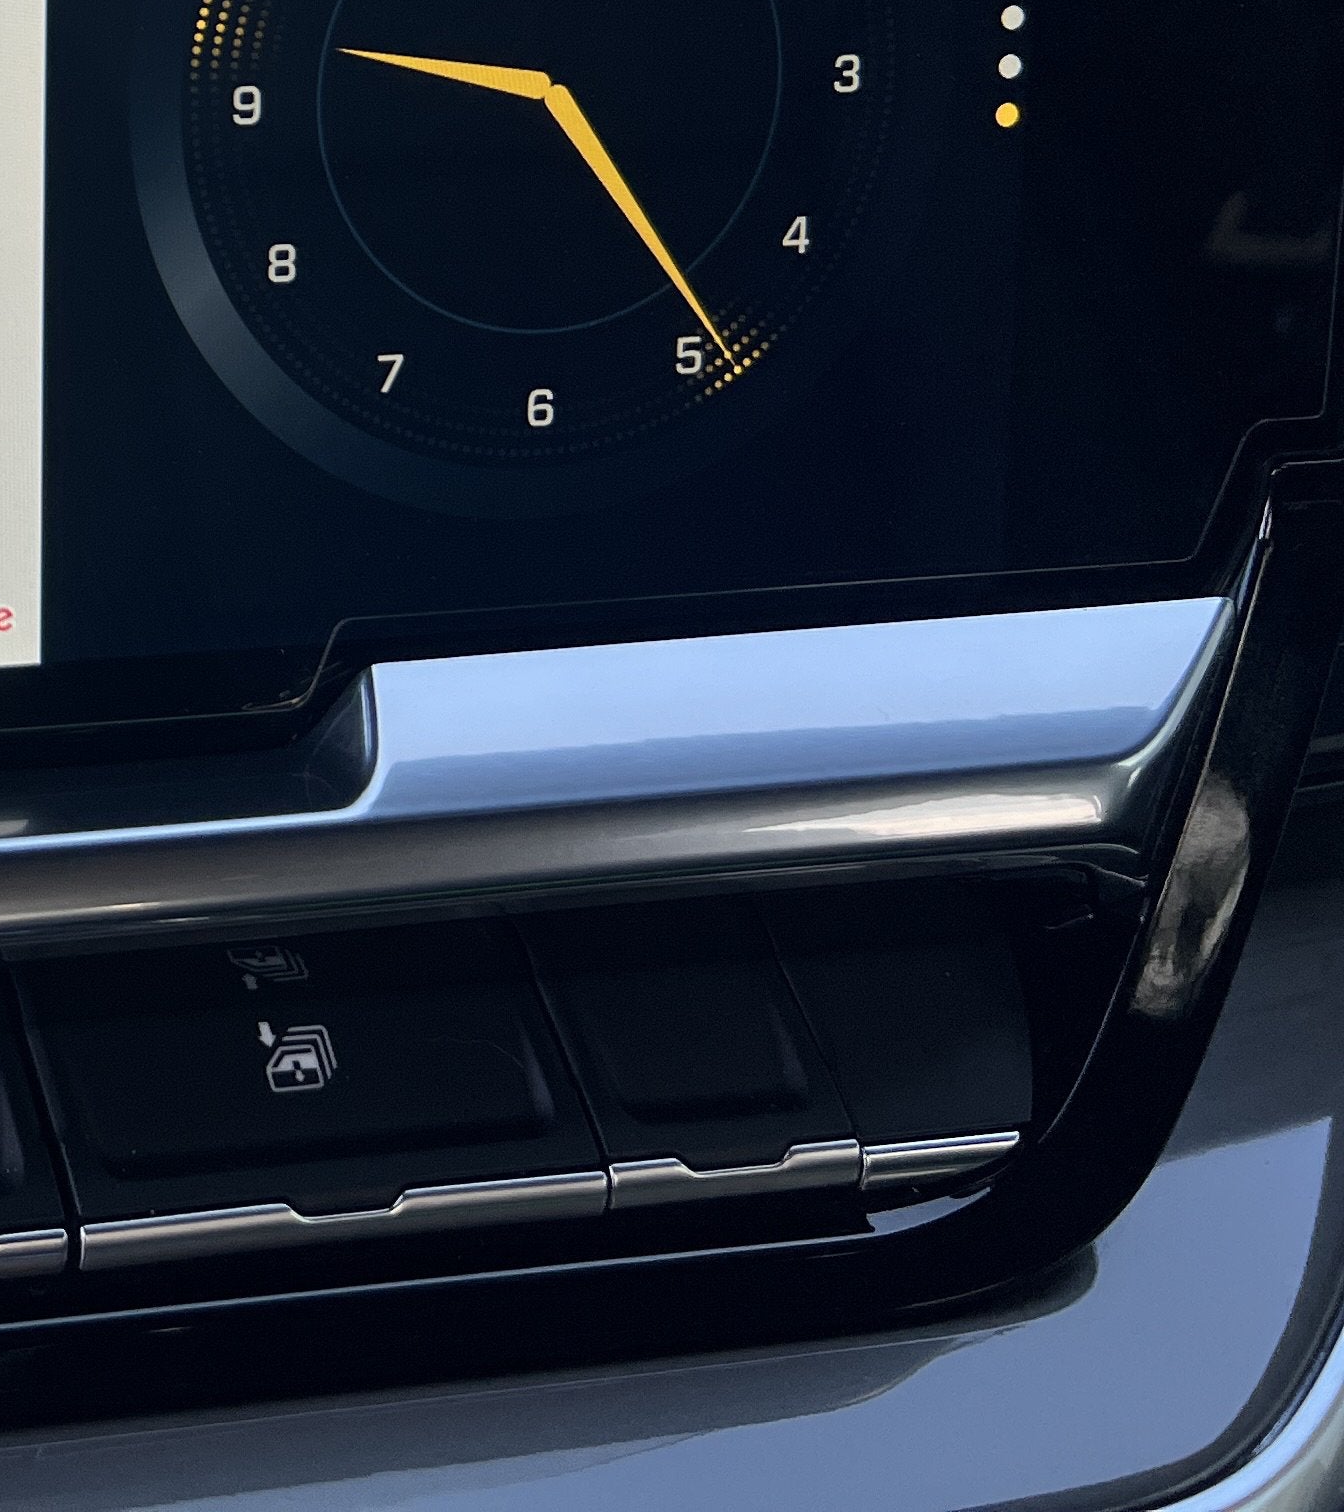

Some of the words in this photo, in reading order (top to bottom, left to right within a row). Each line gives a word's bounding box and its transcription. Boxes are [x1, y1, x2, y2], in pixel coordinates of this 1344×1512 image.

[833, 53, 861, 94] 3
[232, 85, 262, 126] 9
[782, 215, 810, 255] 4
[267, 243, 297, 283] 8
[377, 353, 405, 393] 7
[675, 335, 703, 375] 5
[527, 388, 554, 427] 6
